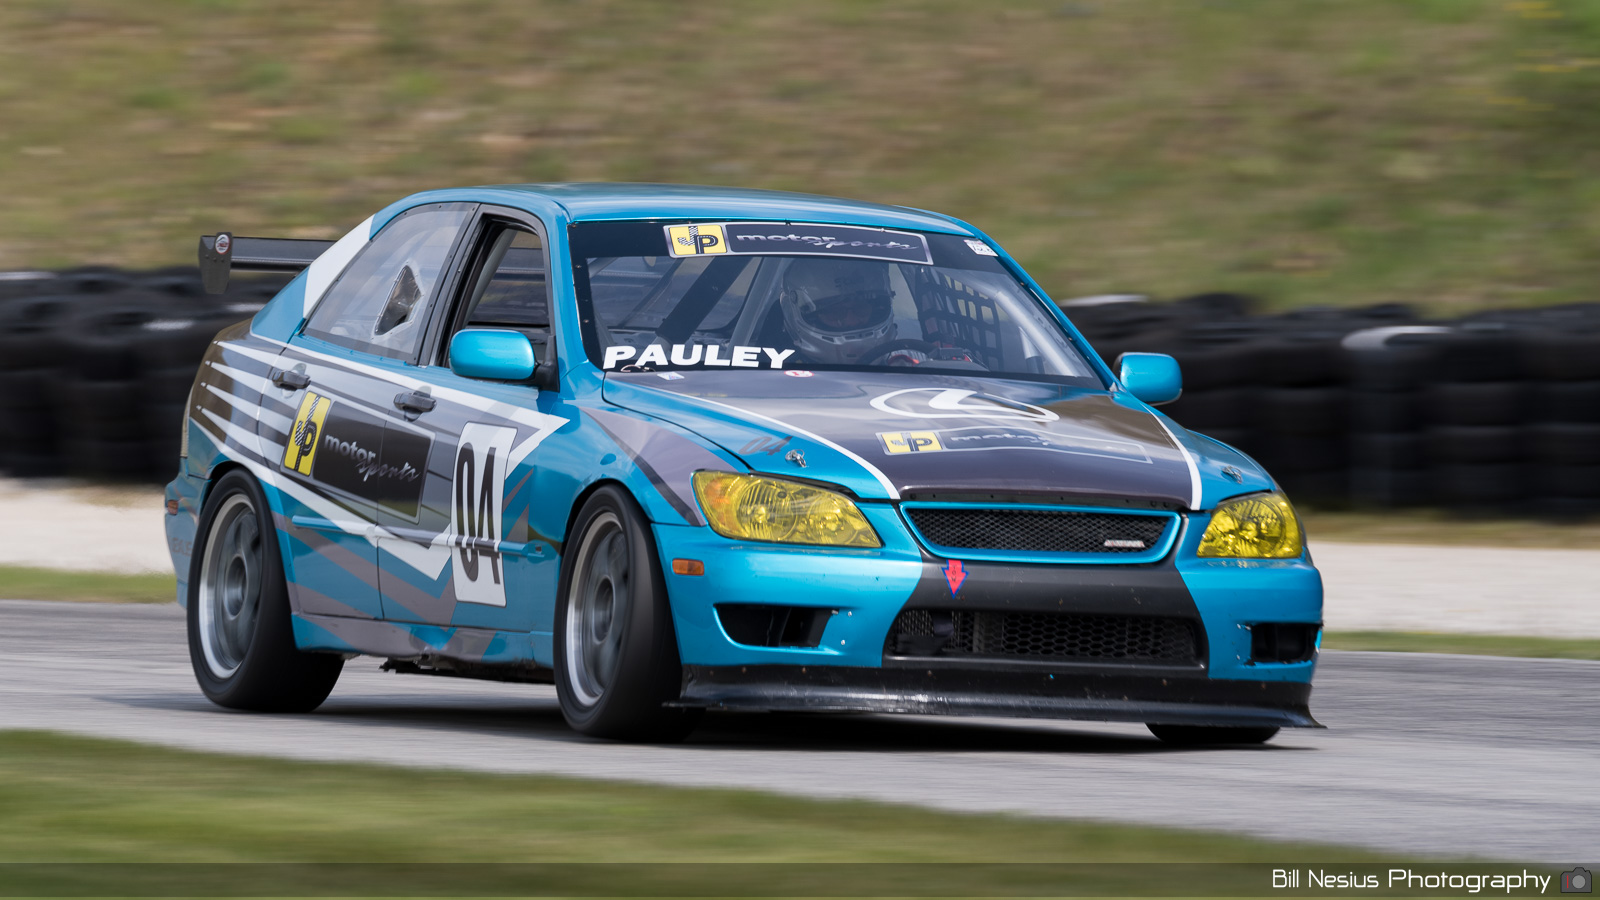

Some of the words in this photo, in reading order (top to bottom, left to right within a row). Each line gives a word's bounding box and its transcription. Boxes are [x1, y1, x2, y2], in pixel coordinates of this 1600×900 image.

[677, 226, 719, 254] JP
[736, 233, 836, 242] motor
[807, 239, 920, 249] sports
[602, 344, 796, 370] PAULEY
[323, 434, 376, 463] motor
[738, 435, 793, 456] 04
[355, 460, 421, 482] sports
[456, 441, 501, 585] 04
